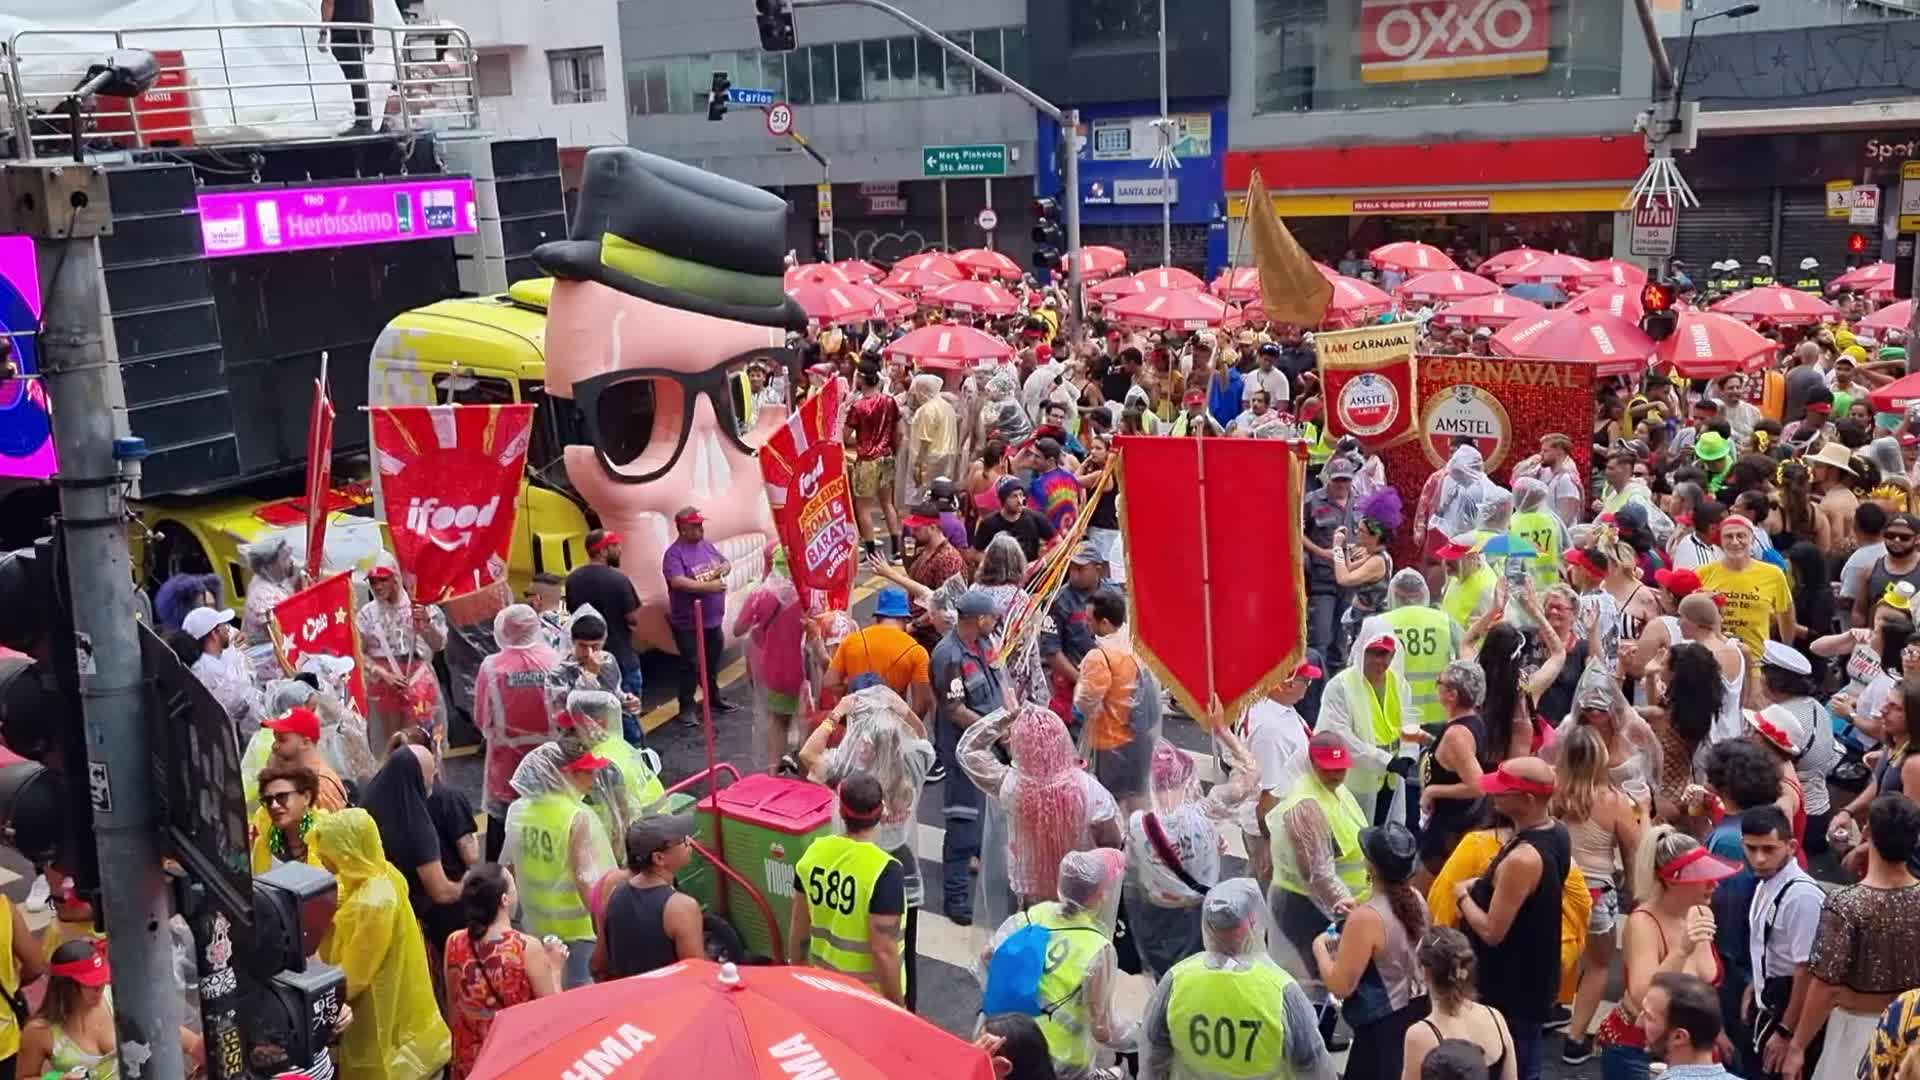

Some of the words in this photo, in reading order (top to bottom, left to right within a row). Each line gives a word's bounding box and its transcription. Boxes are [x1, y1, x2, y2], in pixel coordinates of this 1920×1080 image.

[1376, 0, 1533, 63] OXXO
[738, 91, 772, 104] Carlos
[773, 111, 788, 123] 50
[1331, 344, 1348, 353] AM
[1352, 336, 1410, 351] CARNAVAL
[1423, 359, 1580, 387] CARNAVAL
[1350, 395, 1386, 406] AMSTEL
[1435, 418, 1494, 434] AMSTEL
[809, 866, 856, 915] 589
[1190, 1014, 1262, 1062] 607
